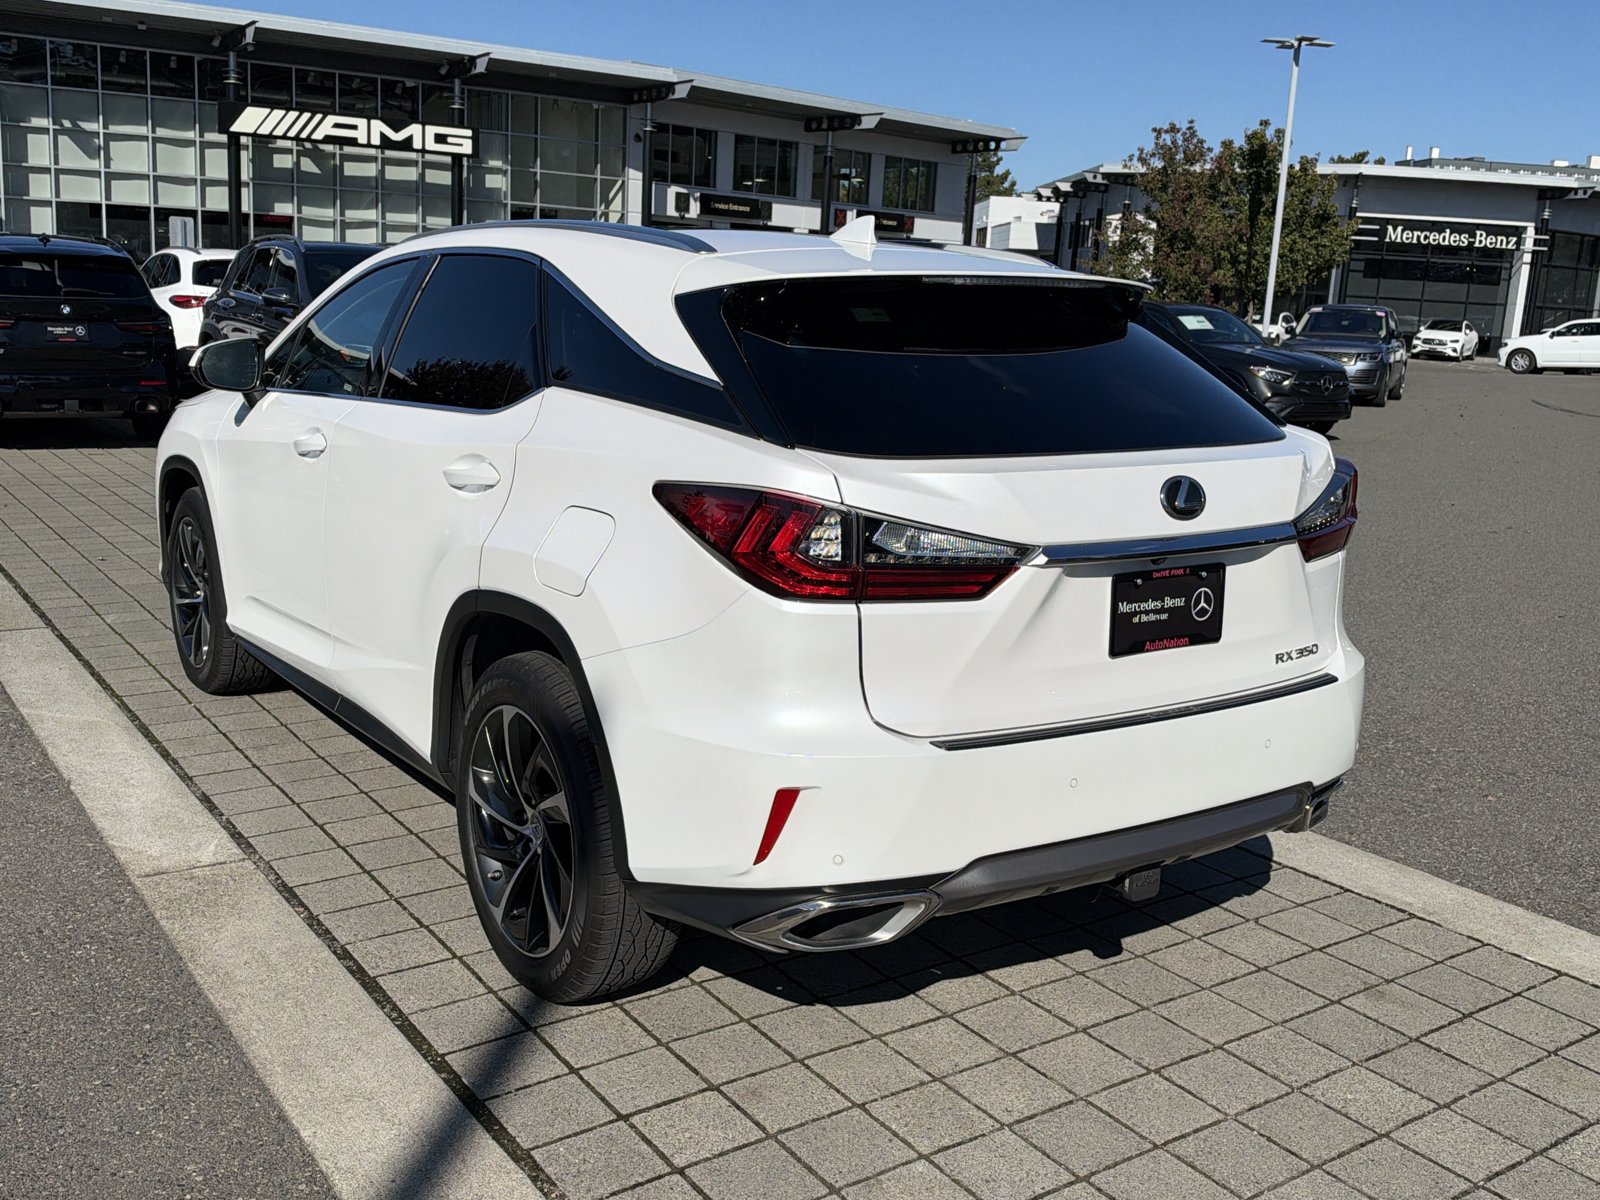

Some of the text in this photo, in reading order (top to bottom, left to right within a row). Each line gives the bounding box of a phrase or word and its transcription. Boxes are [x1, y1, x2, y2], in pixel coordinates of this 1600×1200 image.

[310, 114, 473, 155] AMG
[1384, 225, 1518, 250] Mercedes-Benz
[1152, 568, 1185, 578] DRIVE PINK
[1117, 596, 1186, 614] Mercedes-Benz
[1132, 613, 1169, 623] of Bellevue
[1144, 637, 1190, 651] AutoNation
